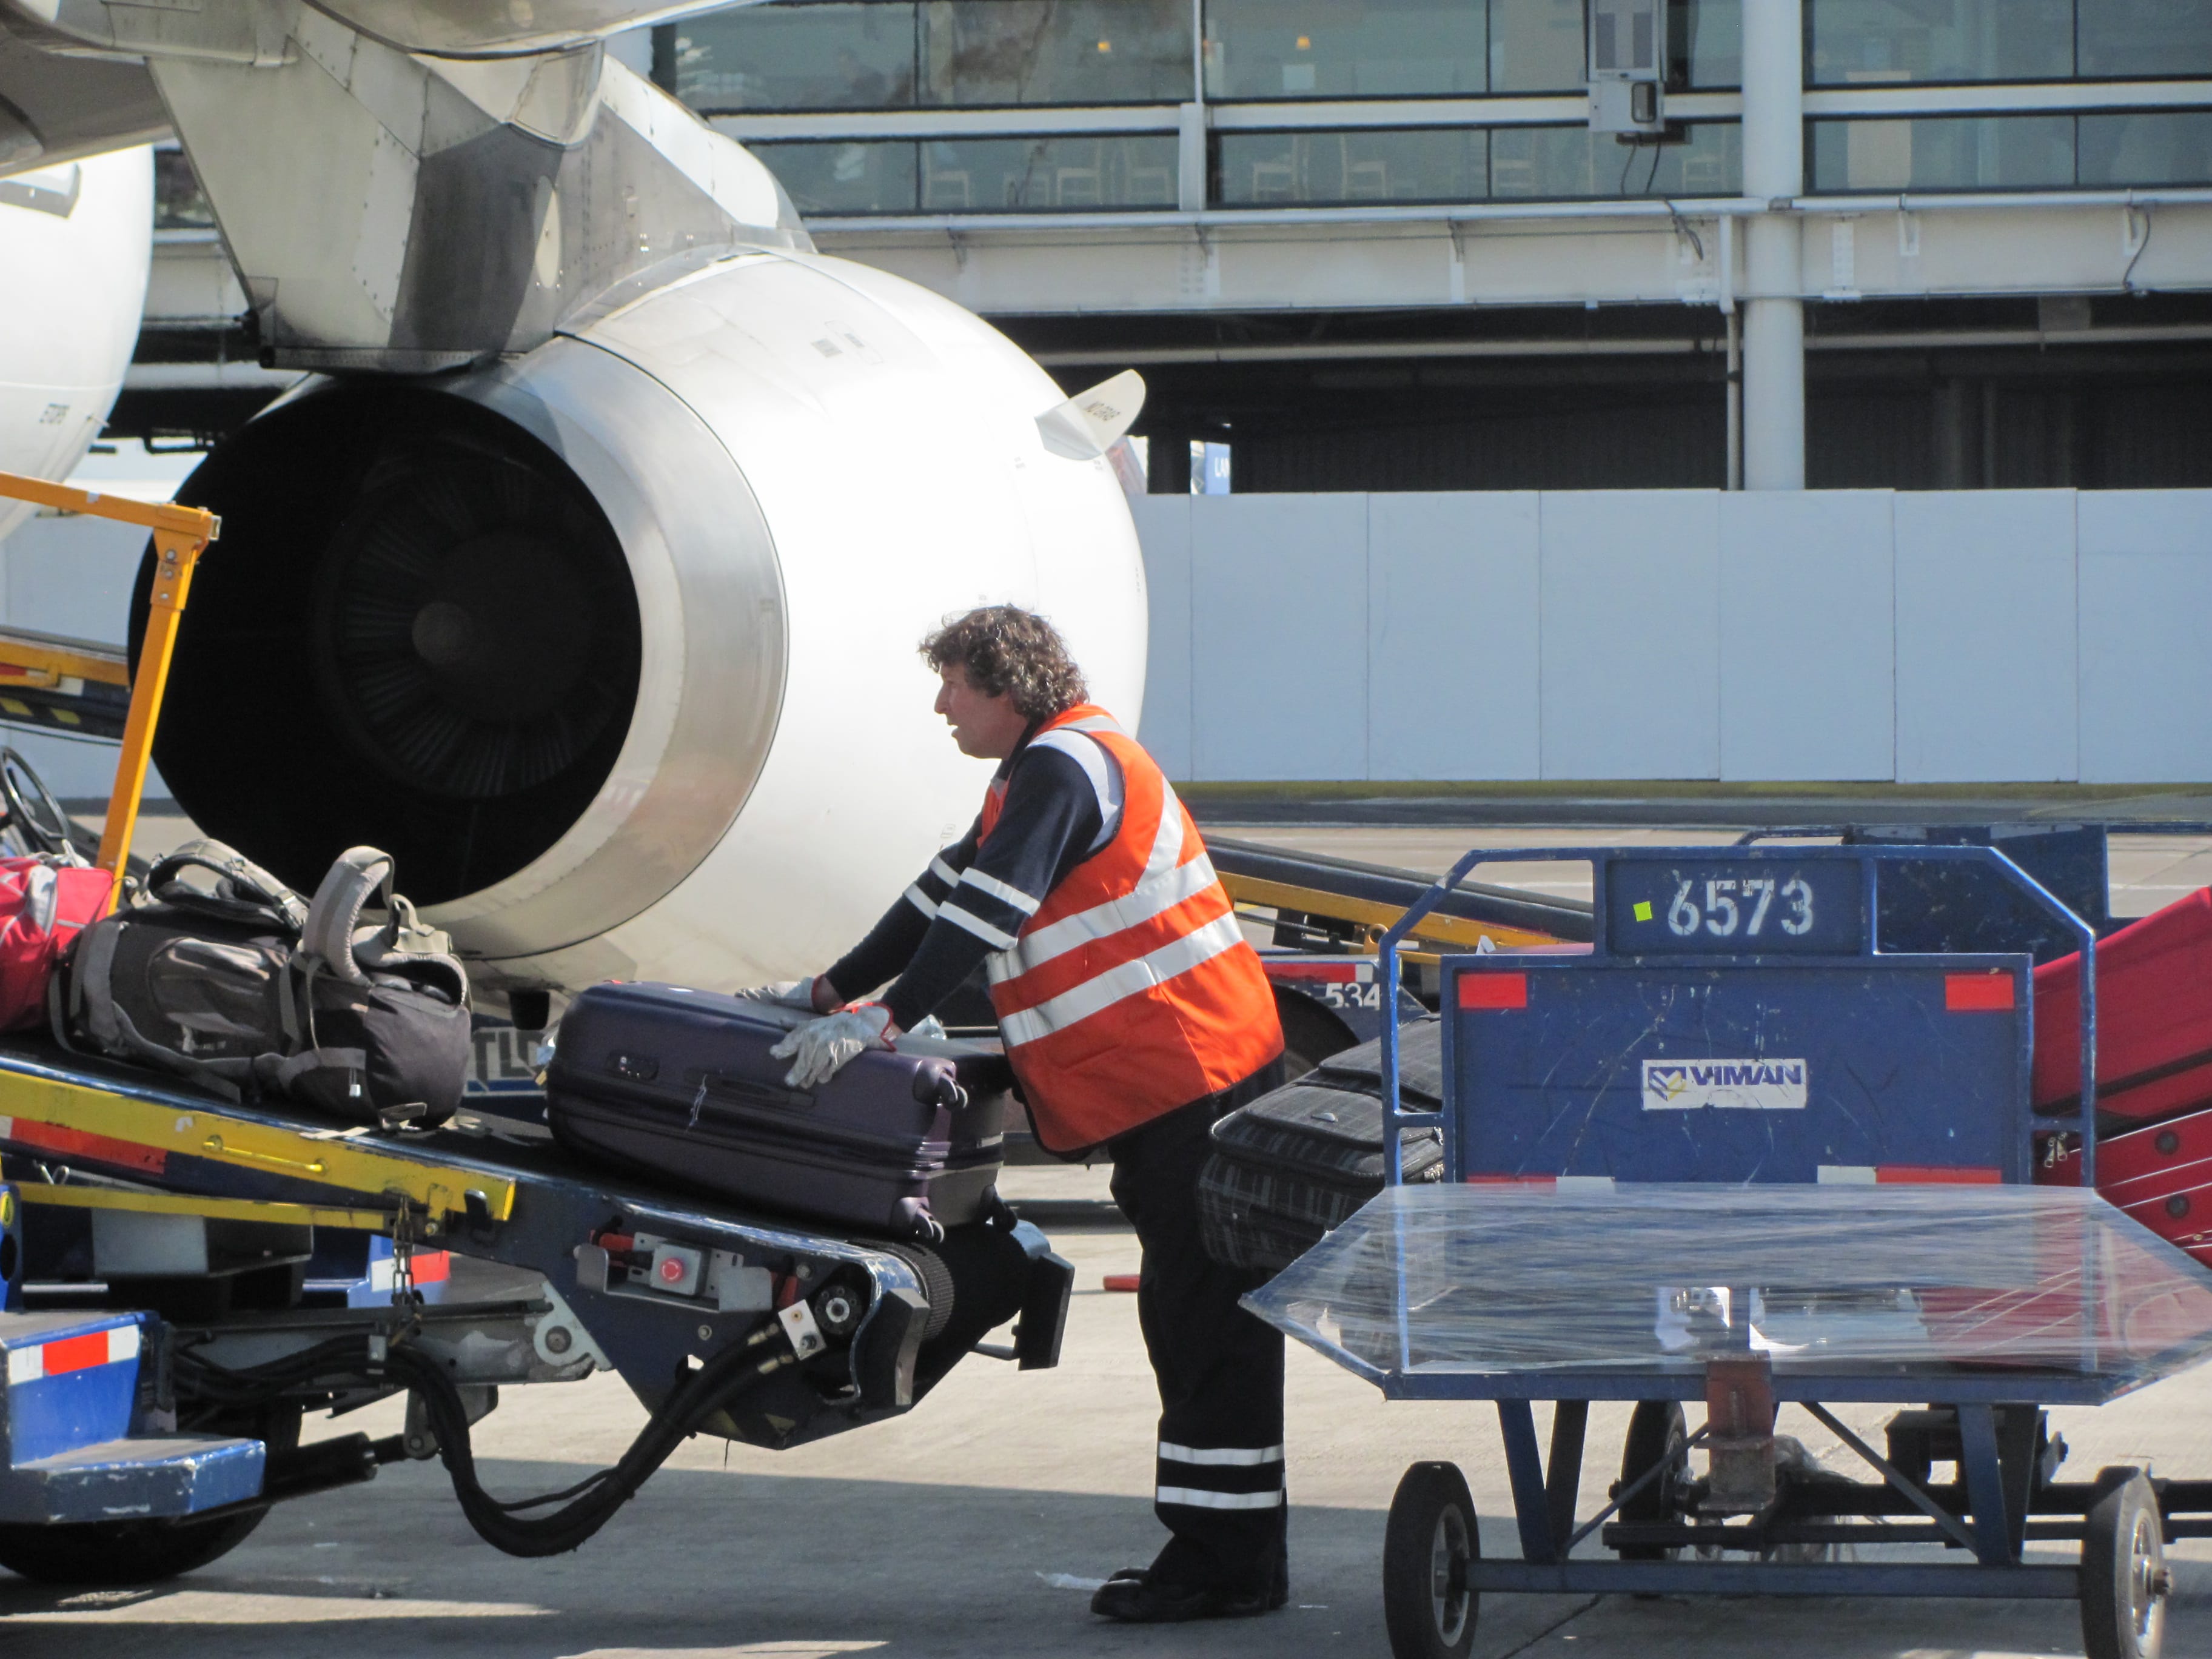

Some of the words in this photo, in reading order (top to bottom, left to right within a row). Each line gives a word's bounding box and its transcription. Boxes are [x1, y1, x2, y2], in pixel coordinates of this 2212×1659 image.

[1668, 879, 1812, 936] 6573
[1326, 982, 1380, 1010] 534
[1690, 1065, 1801, 1085] VIMAN
